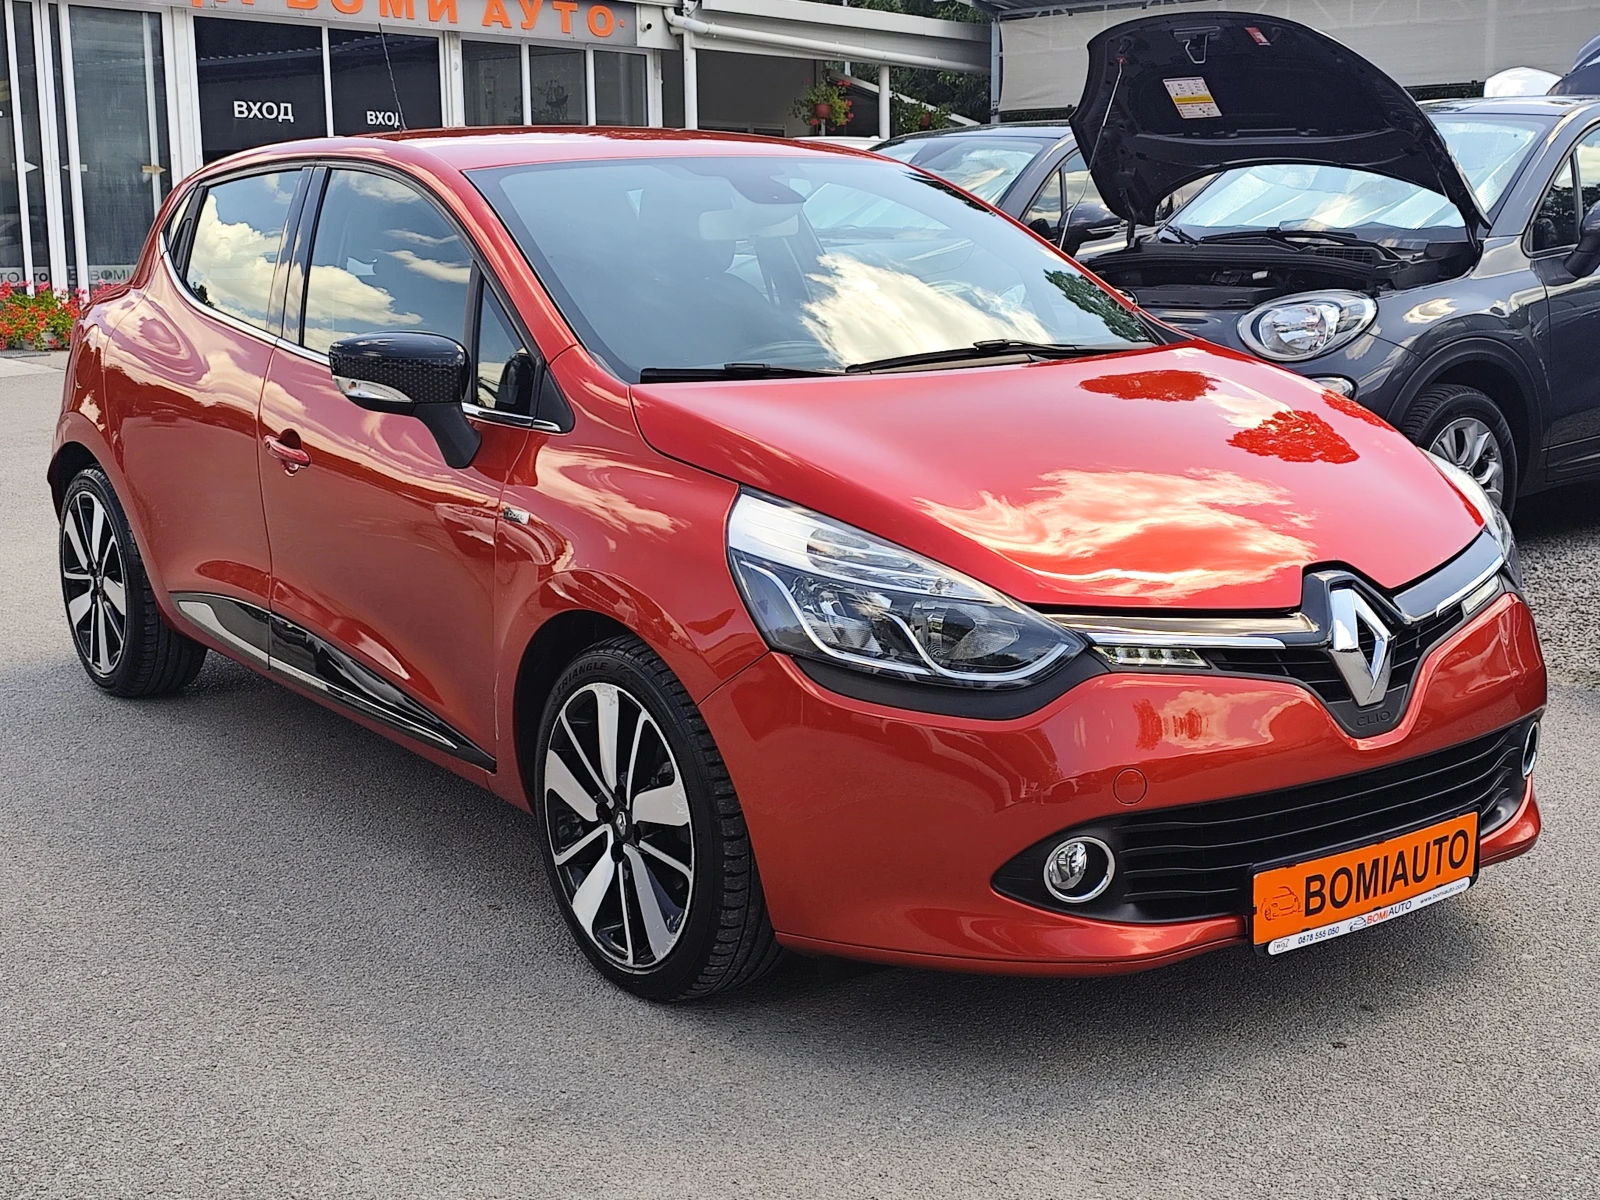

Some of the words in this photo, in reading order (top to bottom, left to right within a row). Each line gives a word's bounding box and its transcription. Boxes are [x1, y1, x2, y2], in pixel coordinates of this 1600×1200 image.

[233, 100, 294, 124] ВХОД
[556, 662, 608, 694] TRIANGLE
[1356, 710, 1391, 727] CLIO
[1304, 829, 1469, 918] BOMIAUTO
